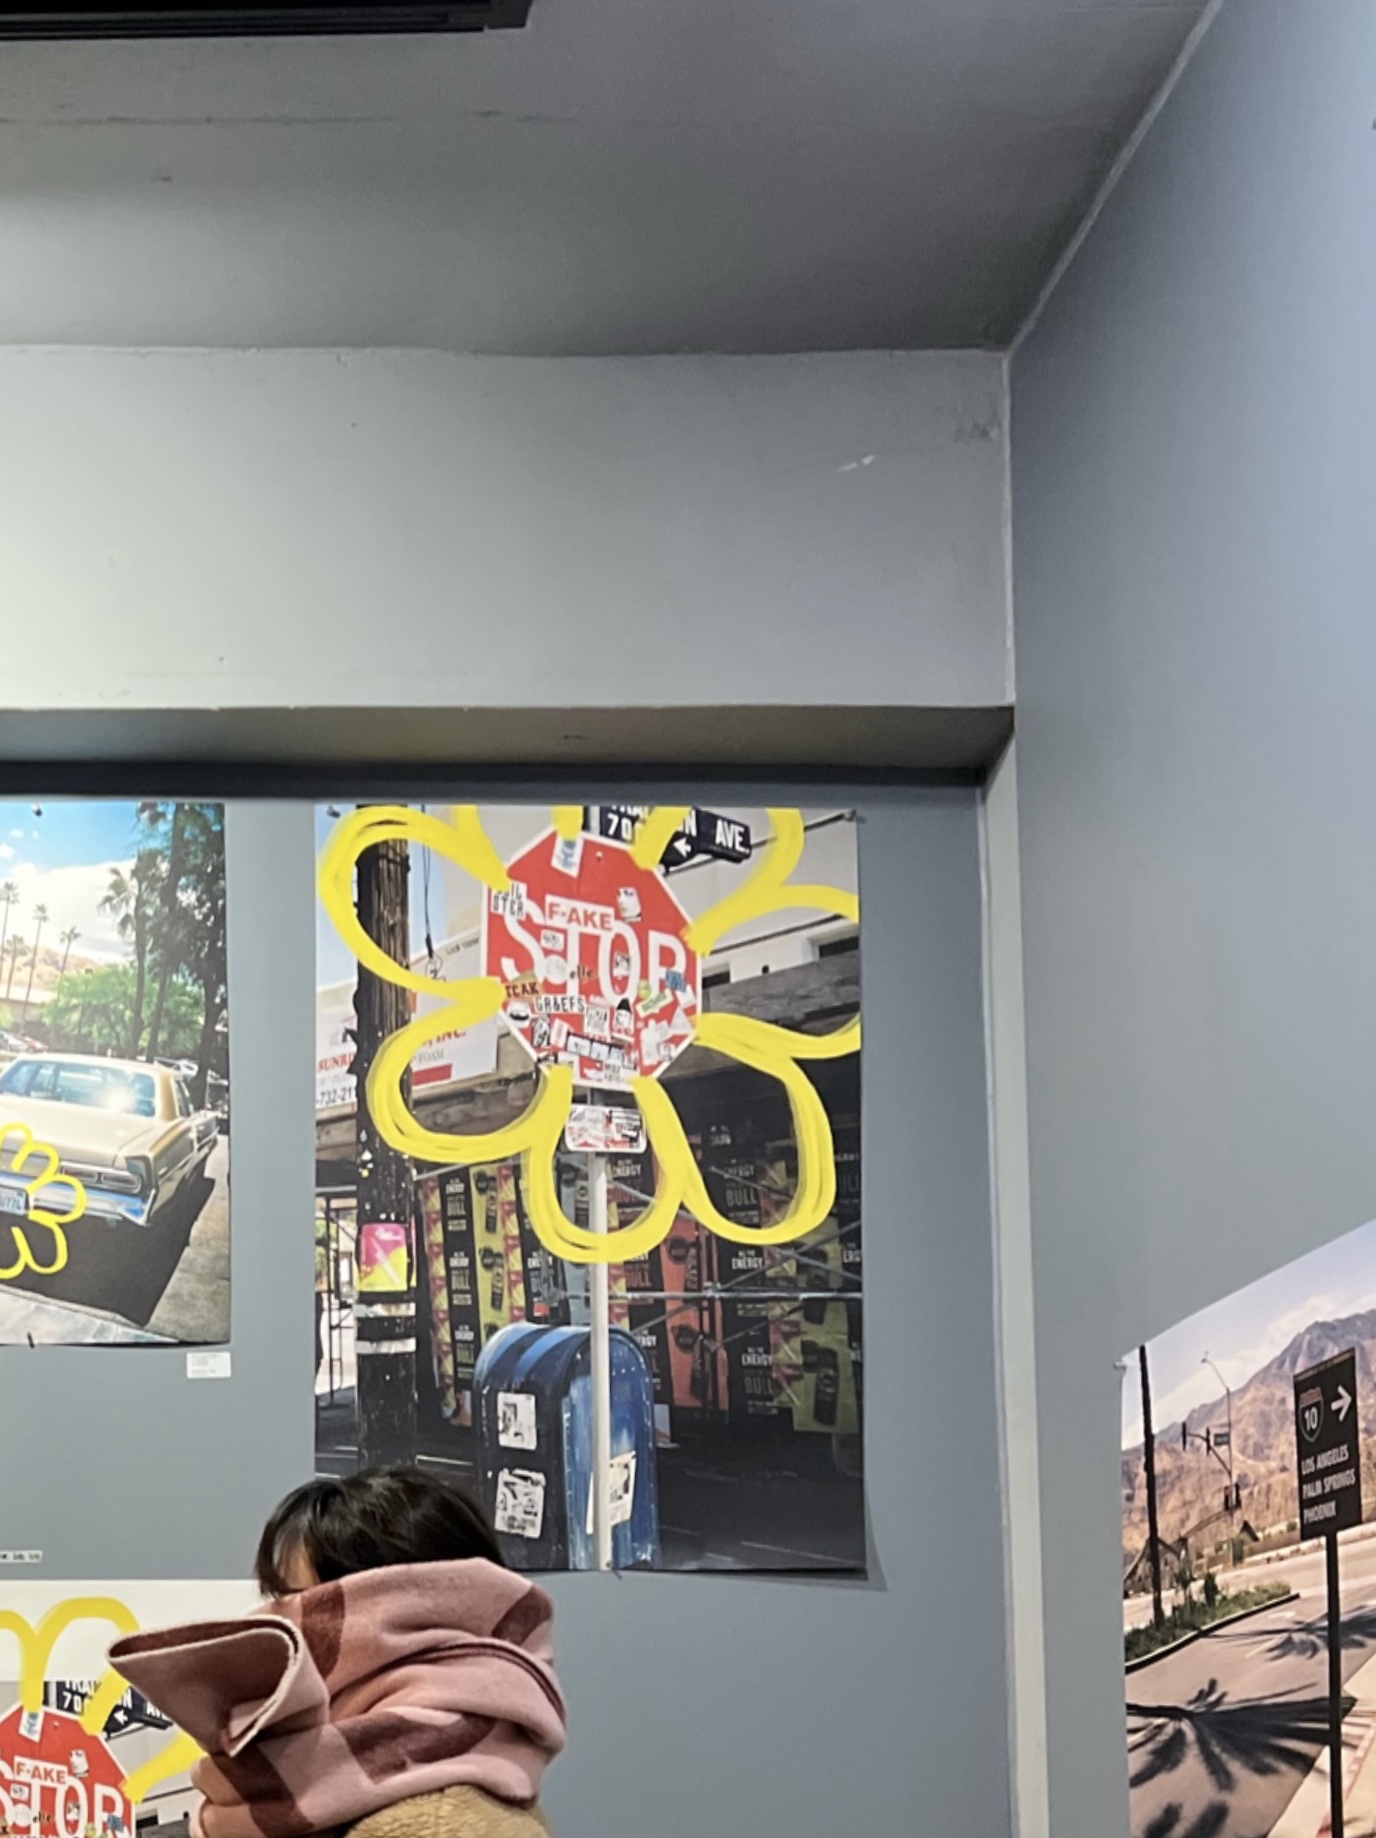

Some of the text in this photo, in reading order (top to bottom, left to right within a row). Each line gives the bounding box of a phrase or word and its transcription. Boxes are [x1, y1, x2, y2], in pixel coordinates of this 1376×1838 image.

[548, 902, 614, 931] F-AKE
[1304, 1406, 1319, 1432] 10
[1301, 1444, 1349, 1475] LOS ANGELES
[1323, 1468, 1356, 1493] SPRINGS
[1303, 1500, 1337, 1524] PHOENIX
[16, 1761, 67, 1785] F-AKE
